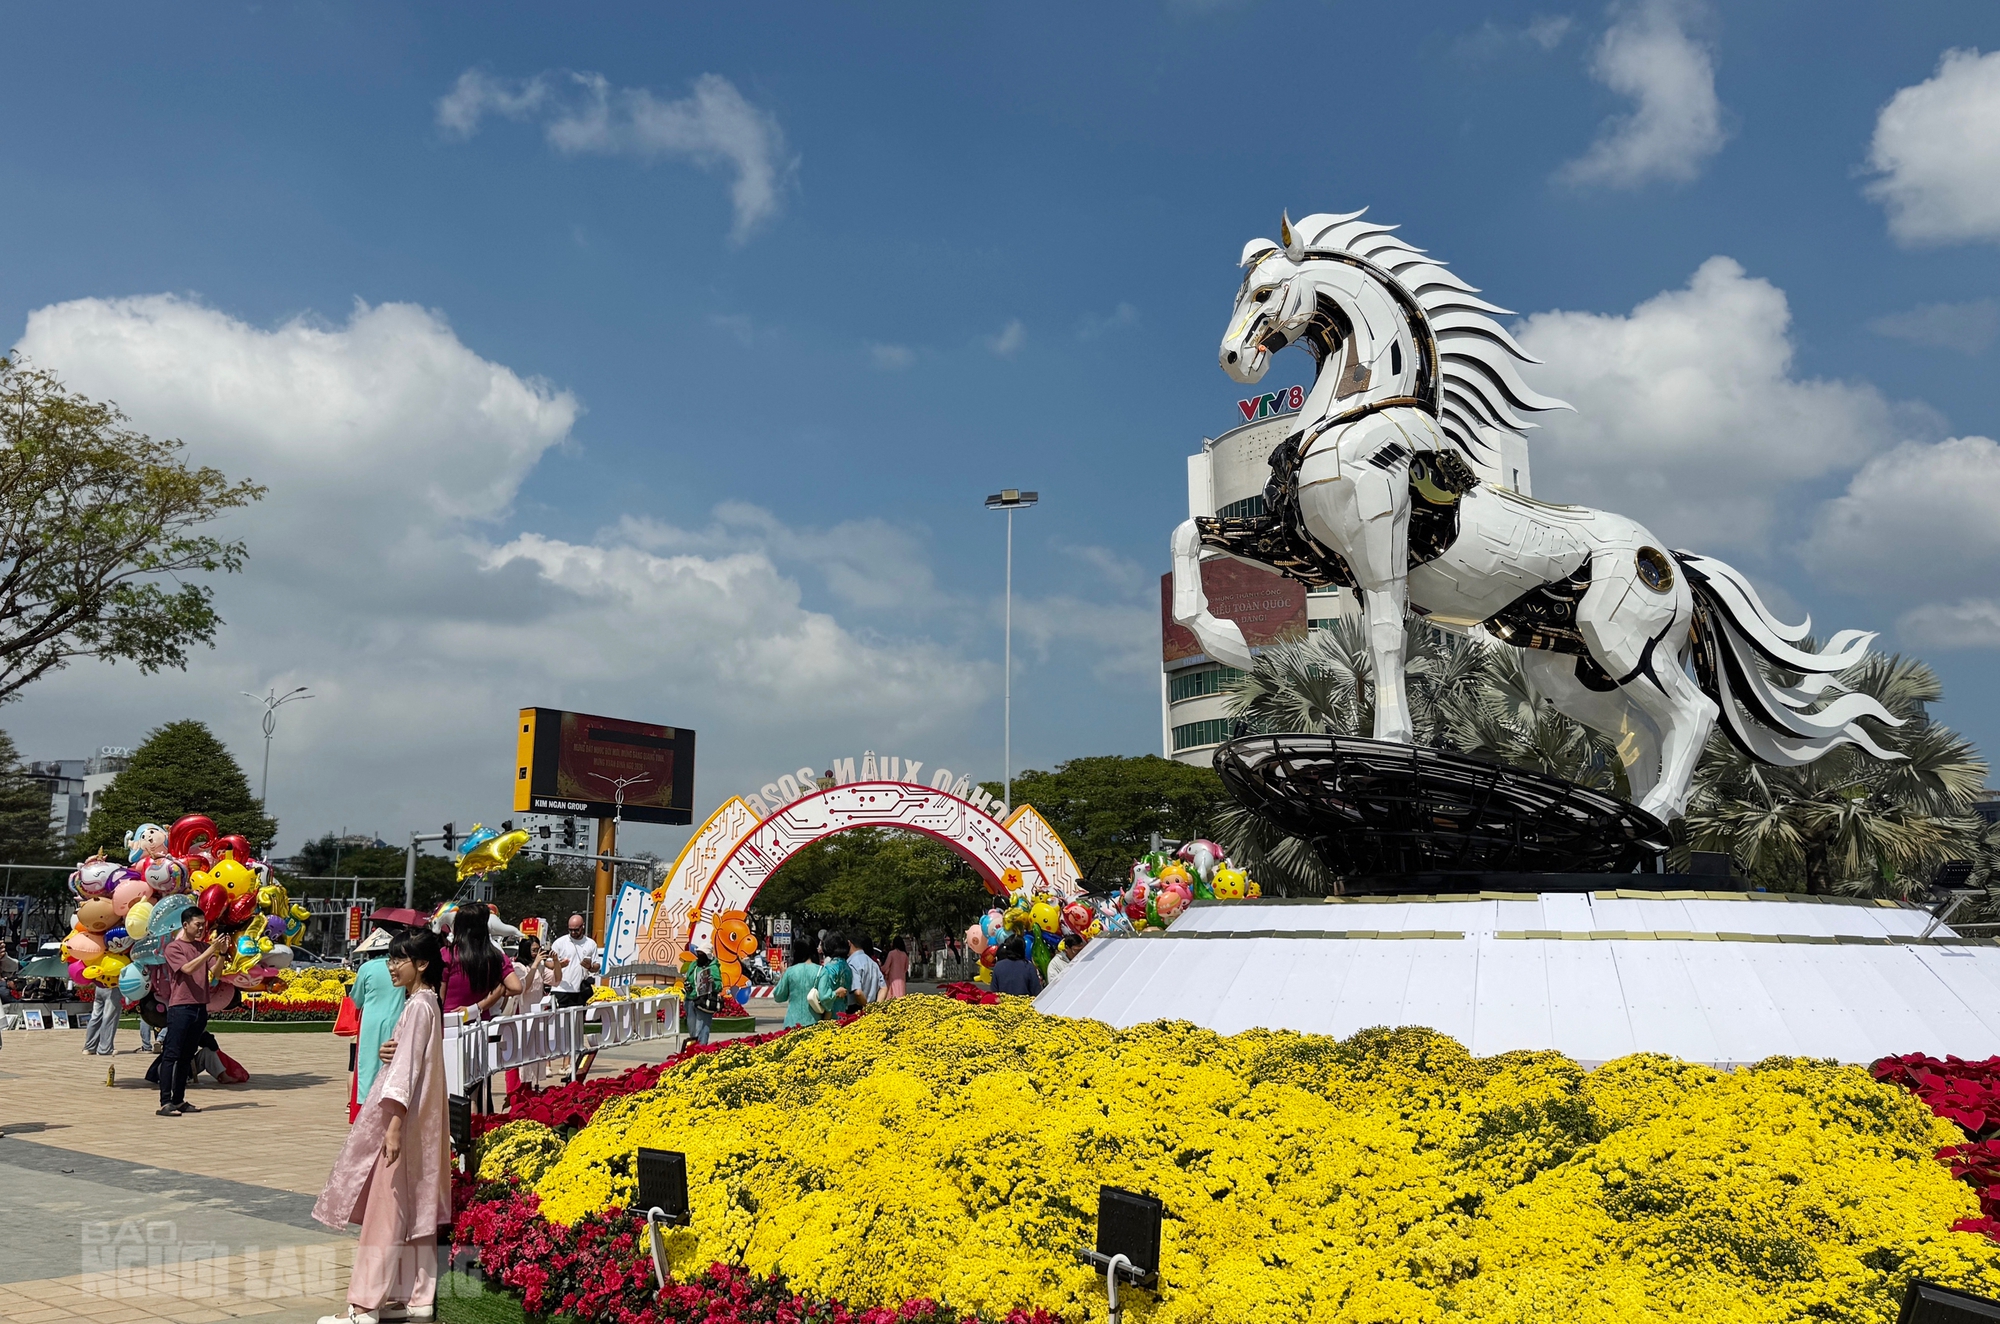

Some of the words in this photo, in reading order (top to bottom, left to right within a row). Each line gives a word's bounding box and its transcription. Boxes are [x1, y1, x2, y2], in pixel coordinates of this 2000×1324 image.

[1237, 385, 1304, 421] VTV8
[1261, 588, 1282, 596] CÔNG
[1233, 600, 1260, 612] TOÀN
[1262, 596, 1292, 610] QUỐC
[101, 746, 130, 755] COZY
[534, 799, 547, 807] KIM
[548, 800, 567, 809] NGAN
[567, 802, 588, 811] GROUP
